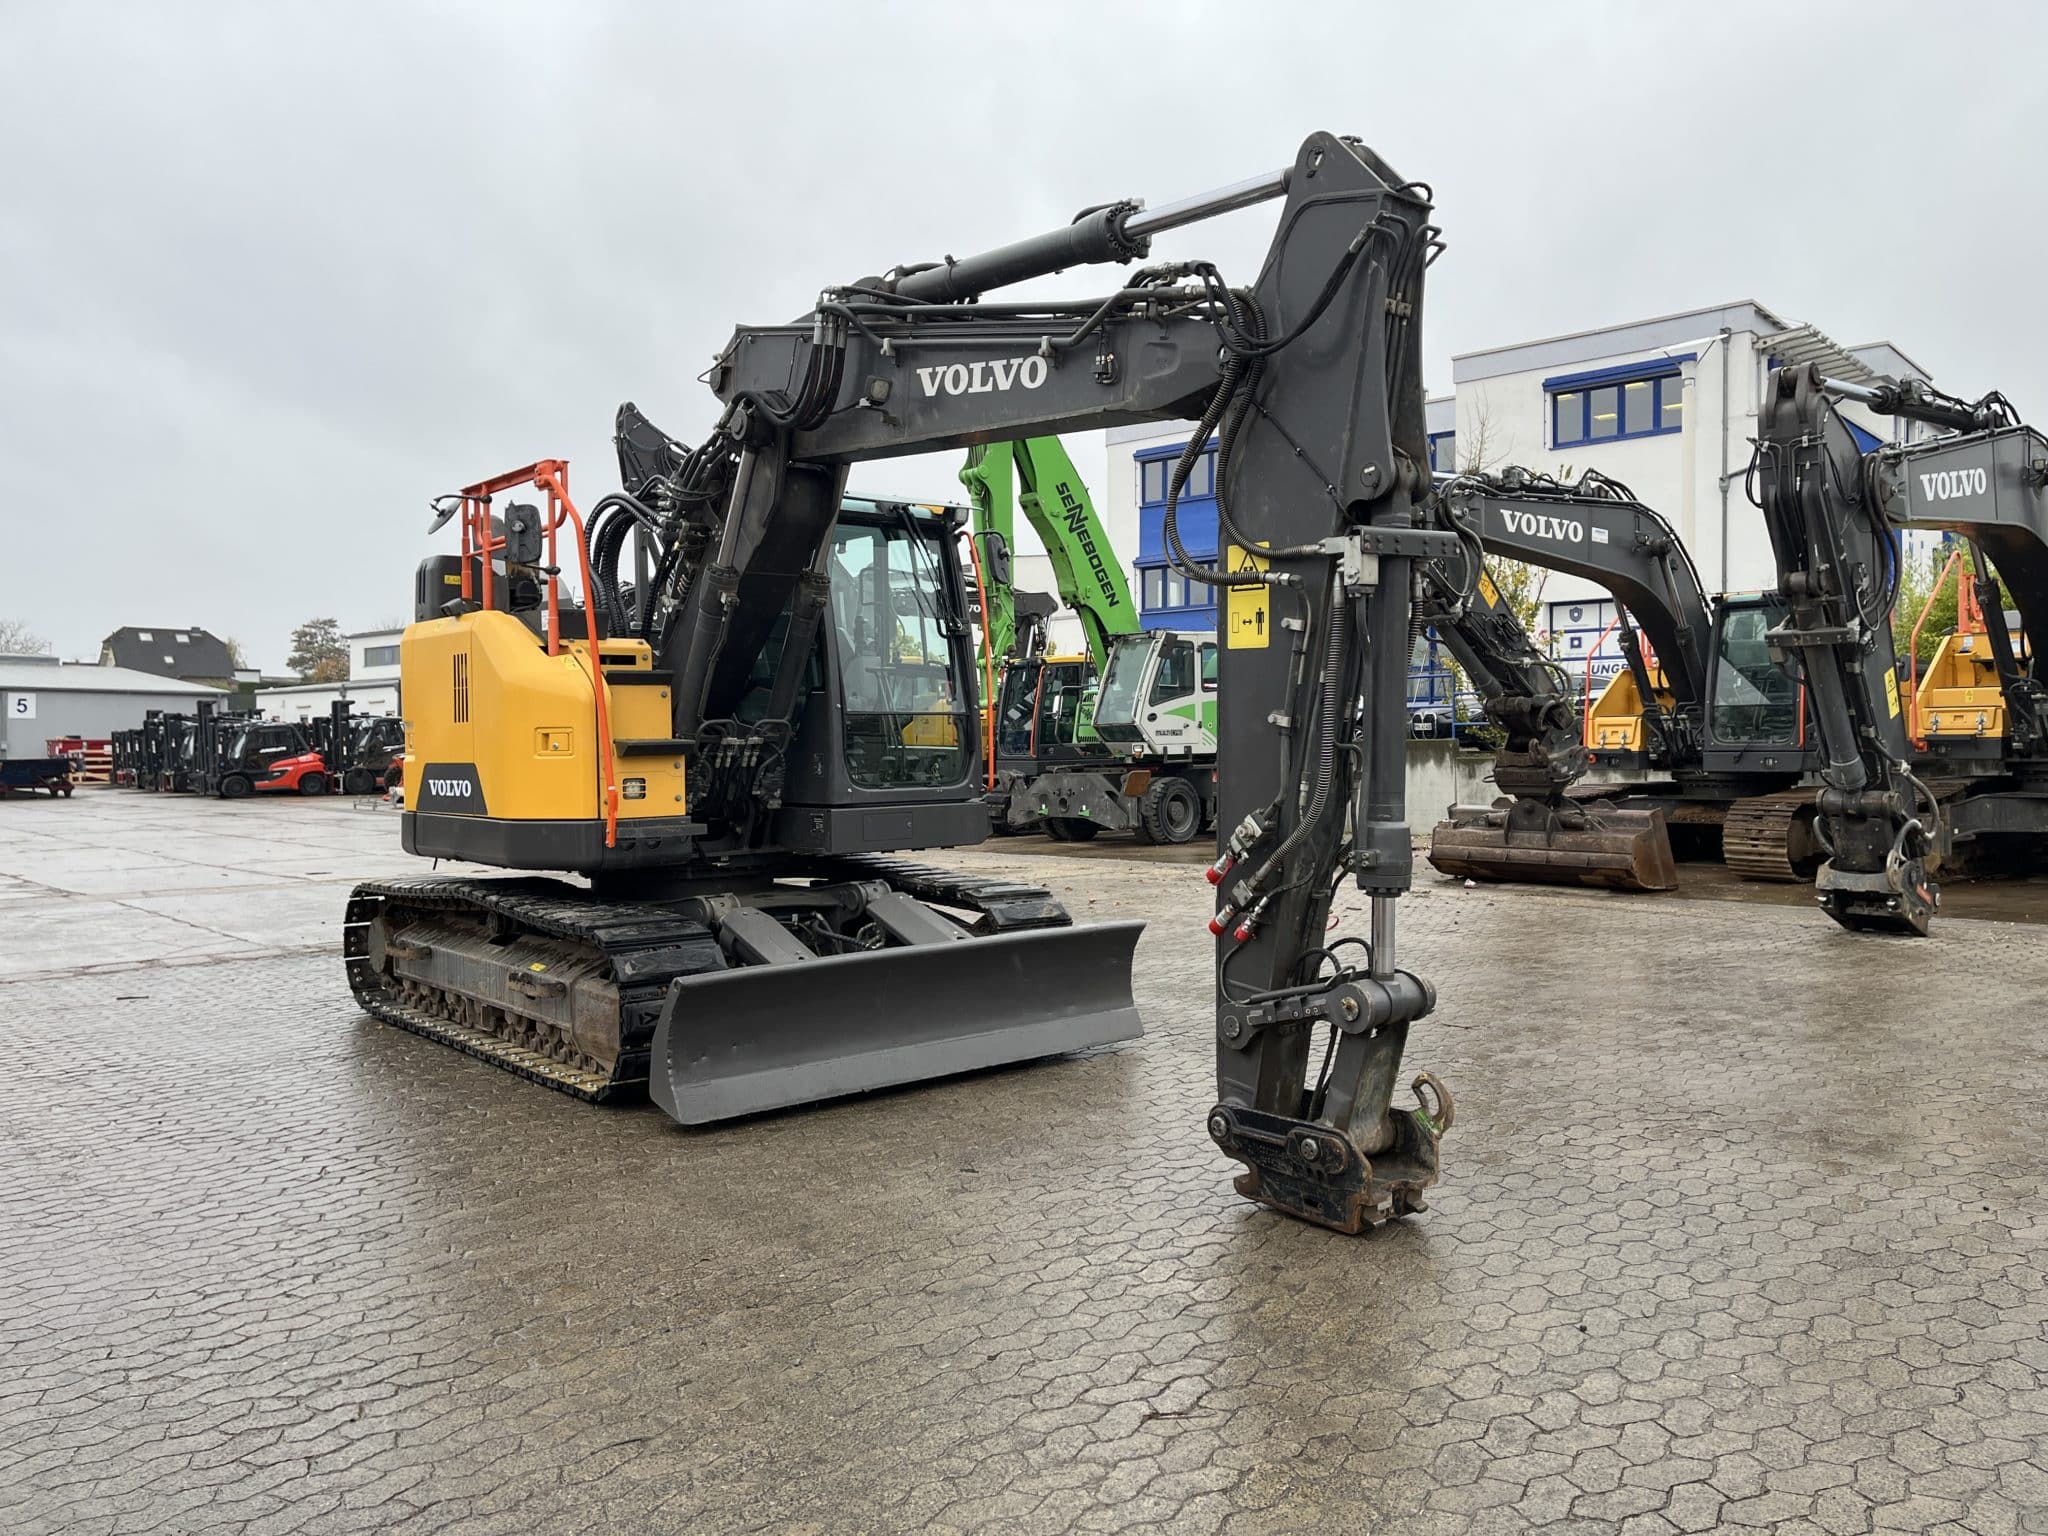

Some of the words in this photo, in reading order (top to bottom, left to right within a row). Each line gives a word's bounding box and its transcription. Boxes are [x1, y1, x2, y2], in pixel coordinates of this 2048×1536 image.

[916, 355, 1048, 397] VOLVO
[1919, 467, 1987, 502] VOLVO
[1500, 508, 1584, 543] VOLVO
[1055, 481, 1120, 608] SENNEBOGEN
[16, 698, 28, 713] 5
[428, 779, 472, 797] VOLVO
